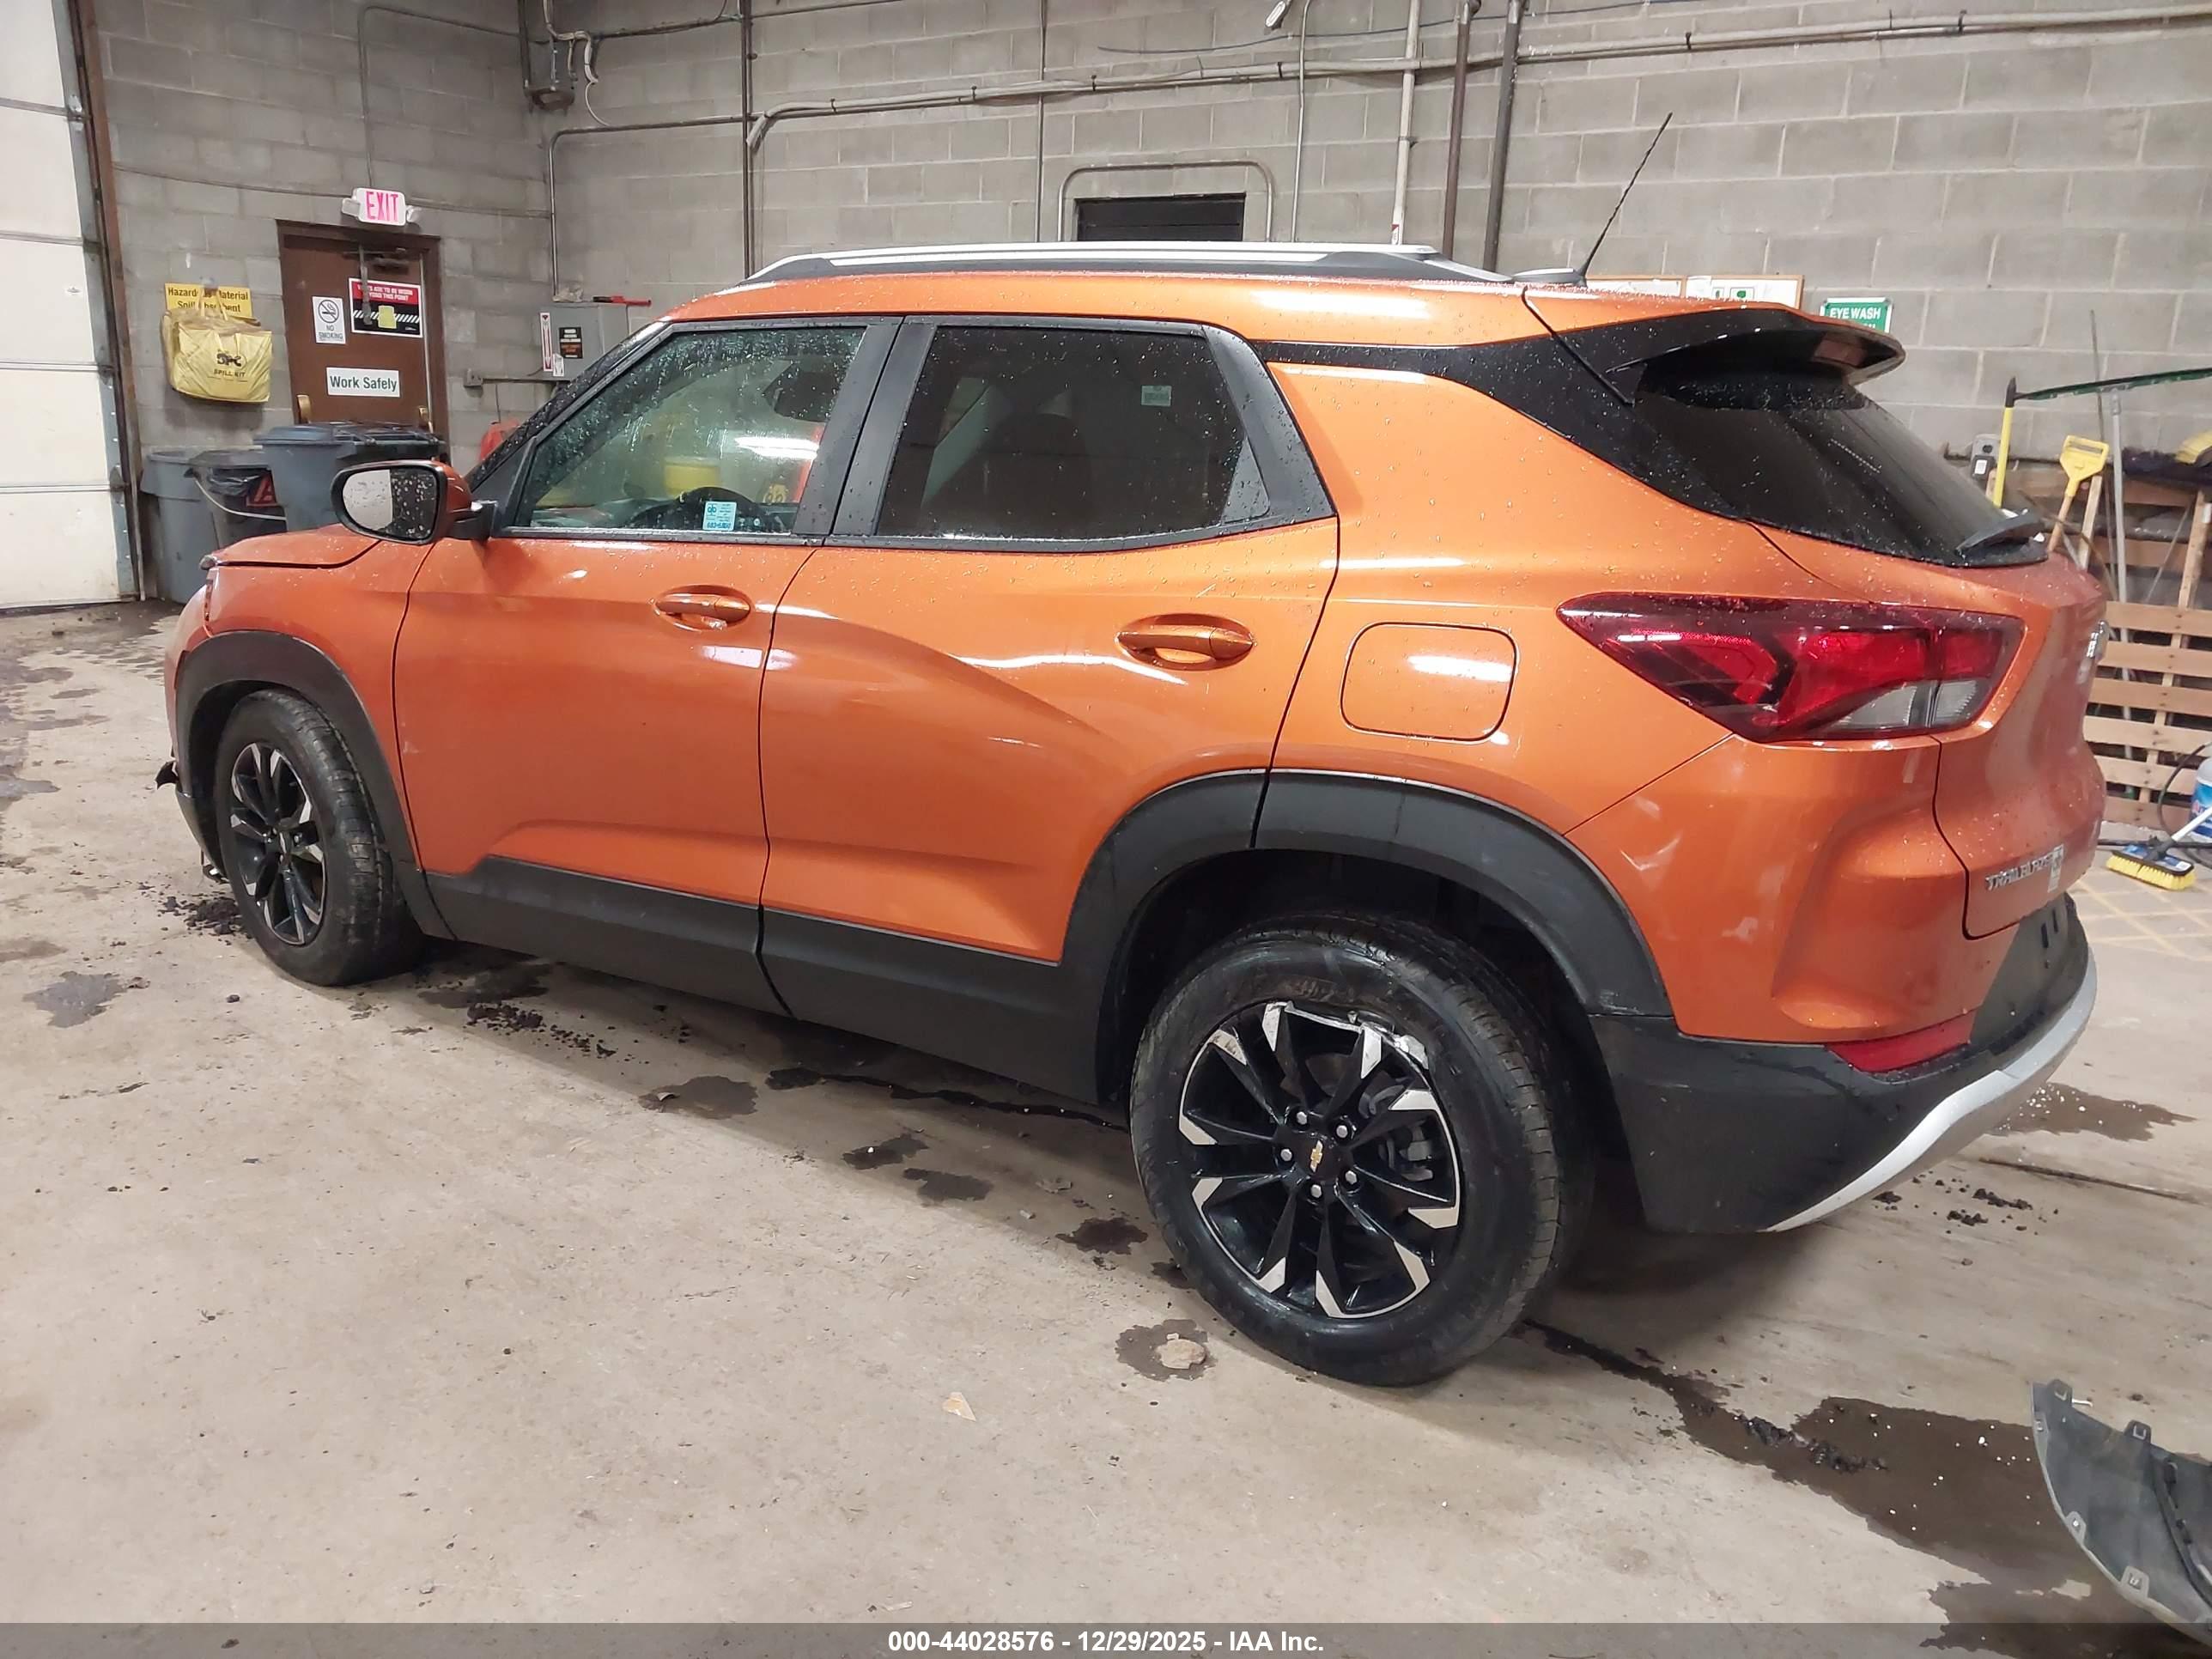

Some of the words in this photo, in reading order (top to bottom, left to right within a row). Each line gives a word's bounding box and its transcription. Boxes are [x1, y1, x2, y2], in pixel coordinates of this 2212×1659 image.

[366, 191, 398, 222] EXIT
[1829, 307, 1850, 319] EYE
[1850, 307, 1881, 320] WASH
[330, 375, 360, 388] Work
[362, 376, 398, 392] Safely
